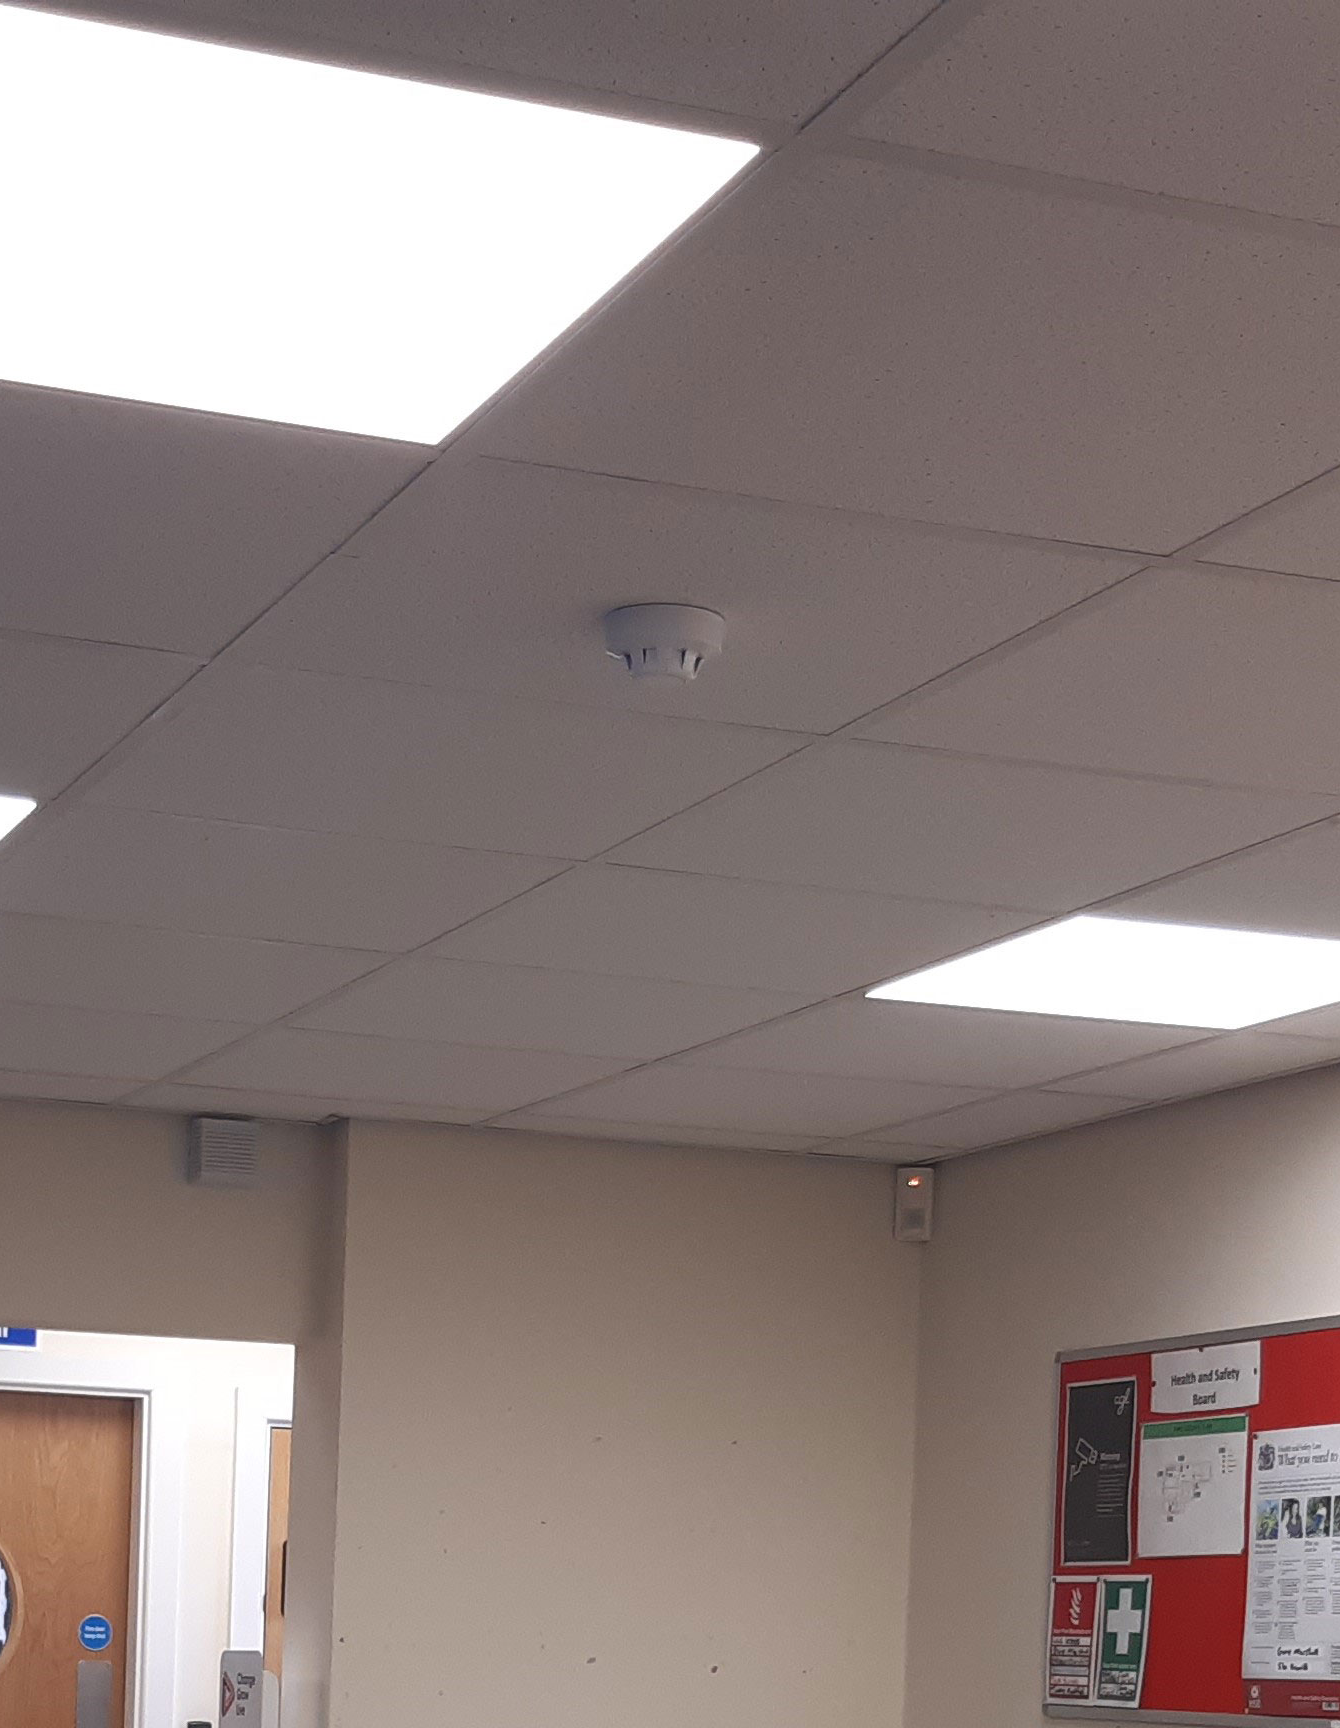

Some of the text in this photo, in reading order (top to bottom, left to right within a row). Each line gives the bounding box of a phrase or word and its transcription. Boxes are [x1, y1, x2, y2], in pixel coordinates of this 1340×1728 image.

[1170, 1367, 1240, 1387] Health and Safety
[1192, 1392, 1216, 1406] Board
[1296, 1456, 1310, 1468] you
[1312, 1449, 1330, 1463] need
[1330, 1452, 1338, 1462] to
